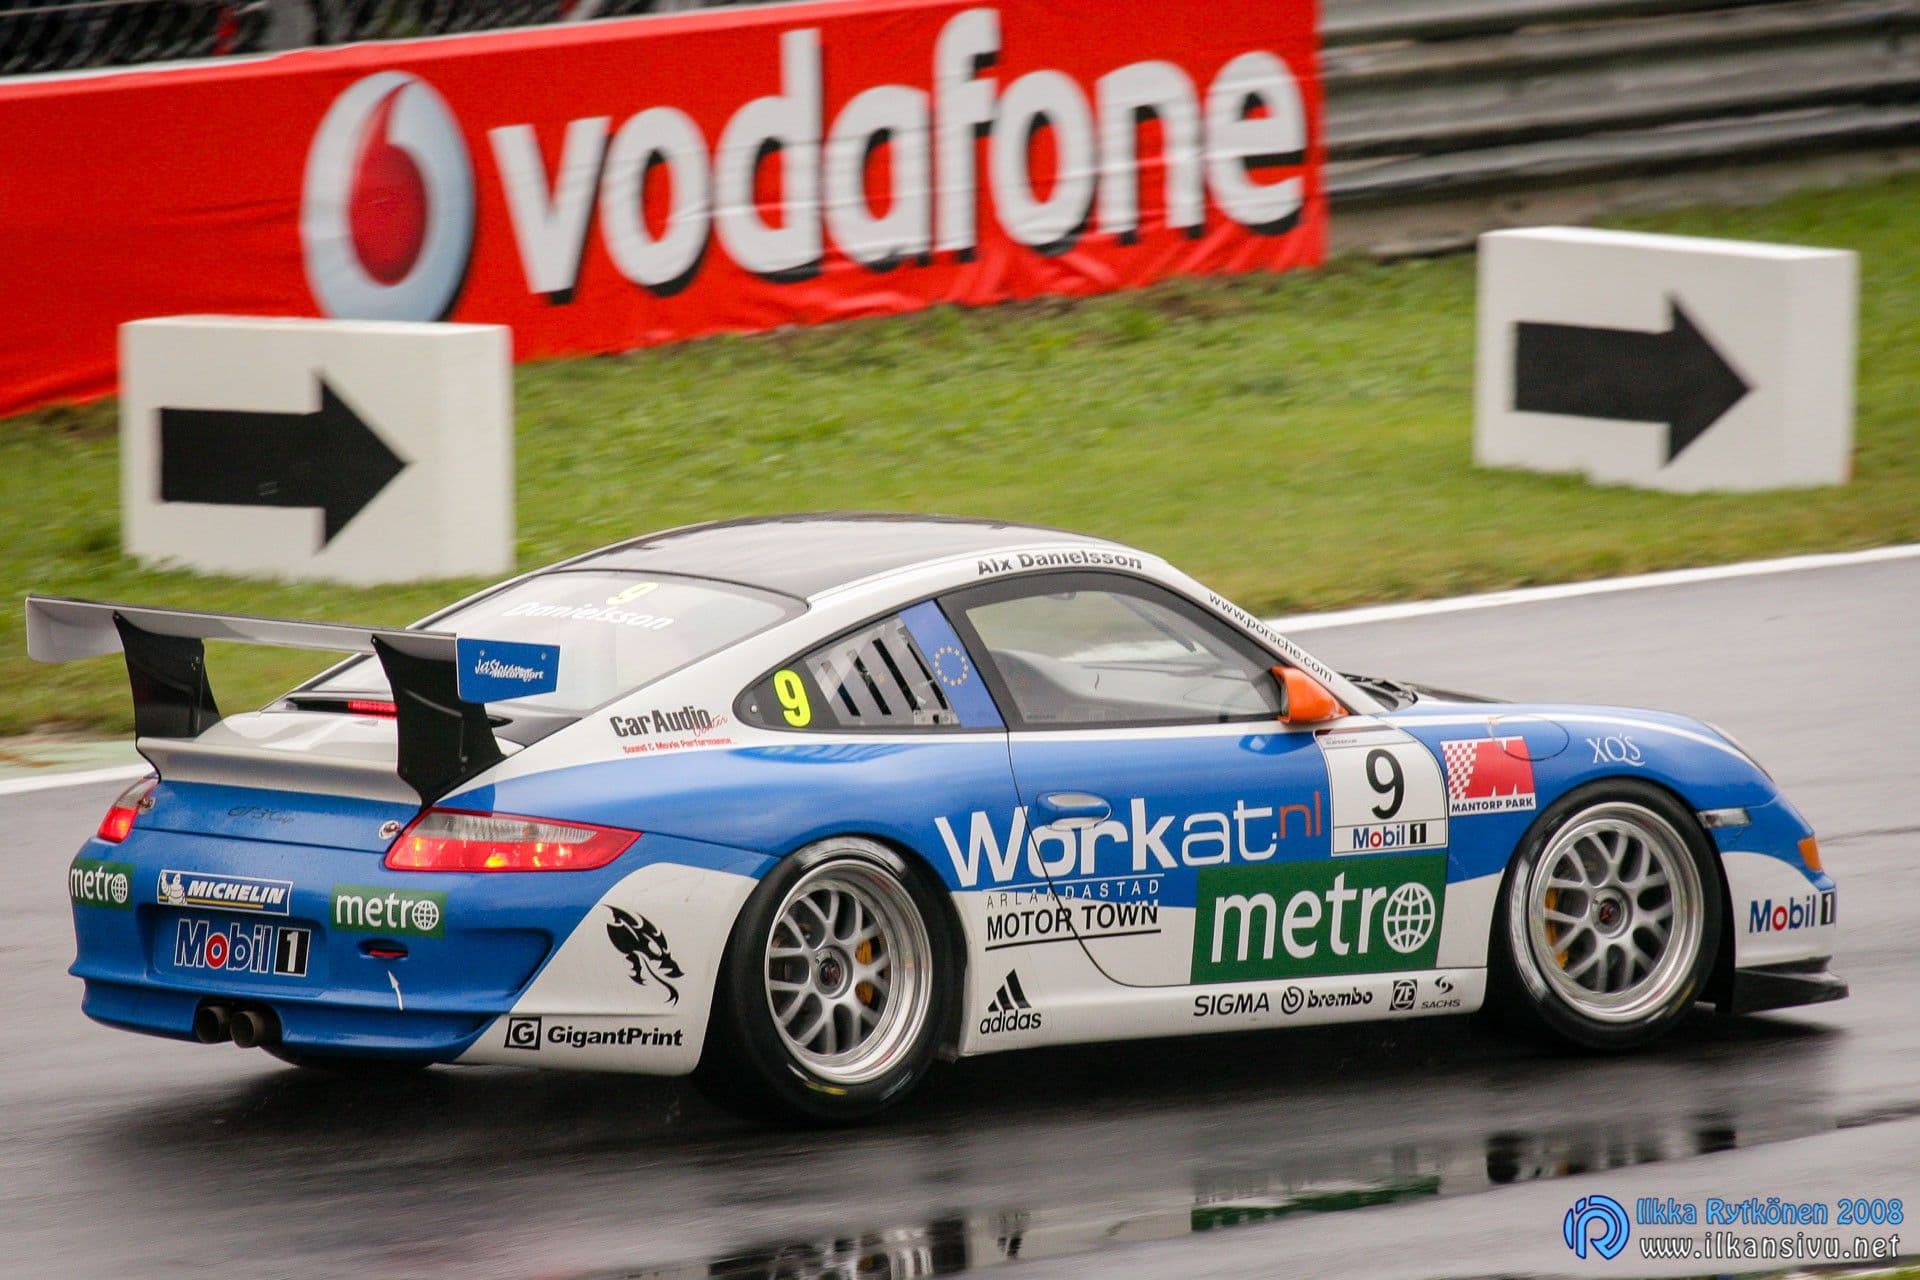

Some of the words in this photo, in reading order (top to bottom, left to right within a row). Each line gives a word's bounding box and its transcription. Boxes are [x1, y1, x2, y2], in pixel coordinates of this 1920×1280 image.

[488, 8, 1308, 298] vodafone
[1017, 550, 1143, 570] Danielsson
[503, 602, 675, 630] Danielsson
[1208, 592, 1334, 684] www.porsche.com
[772, 669, 811, 727] 9
[1366, 748, 1405, 820] 9
[1451, 801, 1503, 813] MANTORP
[1506, 798, 1534, 808] PARK
[1352, 824, 1405, 849] Mobil
[69, 865, 128, 904] metro
[187, 880, 287, 905] MICHELIN
[986, 879, 1159, 910] ARLANDASTAD
[335, 891, 440, 932] metro
[987, 908, 1072, 942] MOTOR
[1081, 900, 1159, 931] TOWN
[1210, 872, 1436, 963] metro
[1749, 895, 1816, 933] Mobil
[174, 918, 273, 974] Mobil
[1193, 991, 1270, 1017] SIGMA
[1307, 987, 1374, 1009] brembo
[1421, 999, 1461, 1010] SACHS
[547, 1025, 683, 1048] GigantPrint
[979, 1010, 1042, 1036] adidas
